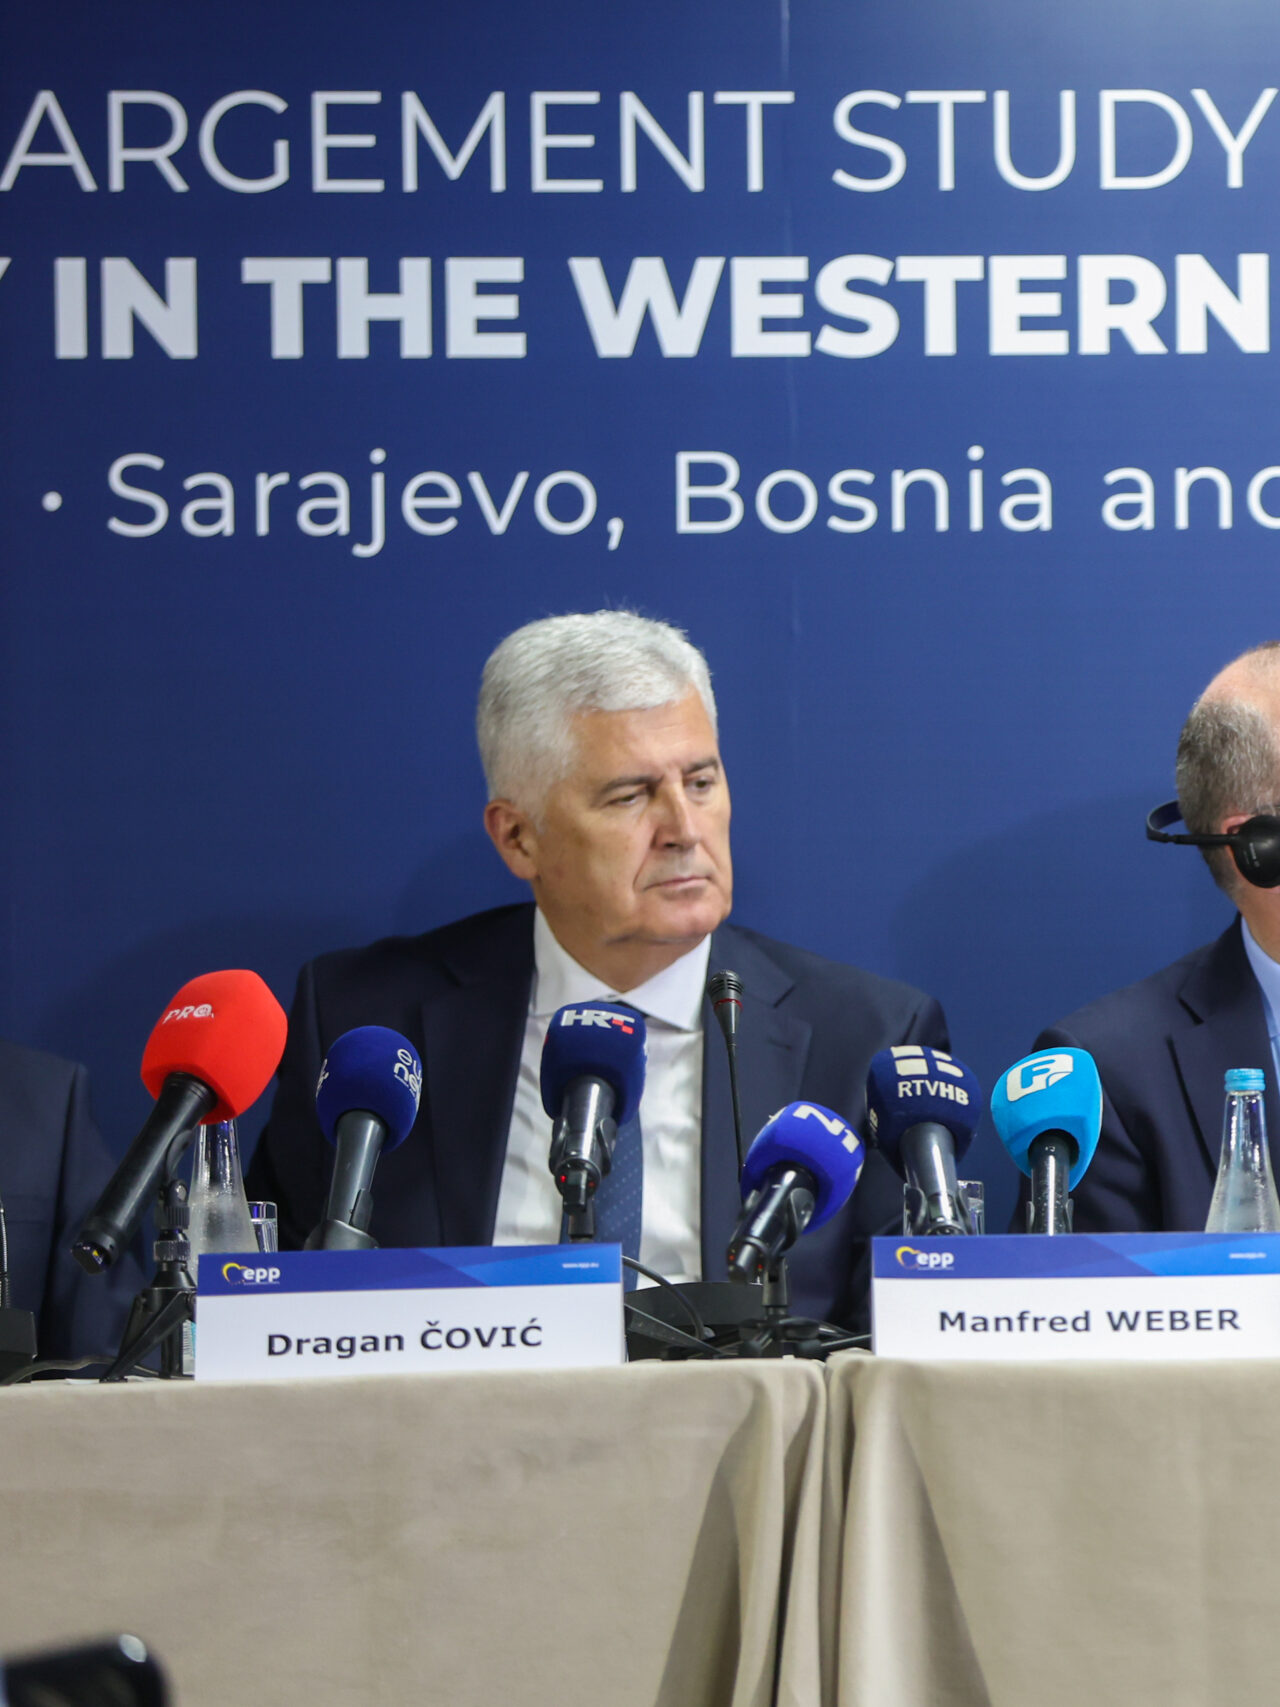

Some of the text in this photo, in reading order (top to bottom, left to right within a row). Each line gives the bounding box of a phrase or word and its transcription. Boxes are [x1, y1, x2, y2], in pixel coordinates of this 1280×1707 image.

[0, 89, 796, 193] ARGEMENT
[831, 87, 1280, 193] STUDY
[54, 256, 198, 359] IN
[241, 256, 528, 359] THE
[567, 252, 1271, 360] WESTERN
[107, 447, 625, 559] Sarajevo,
[675, 444, 1054, 535] Bosnia
[897, 1079, 970, 1106] RTVHB
[791, 1104, 860, 1154] N1
[242, 1266, 281, 1283] epp
[916, 1252, 955, 1269] epp
[267, 1317, 544, 1360] Dragan ČOVIĆ
[938, 1309, 1242, 1333] Manfred WEBER
